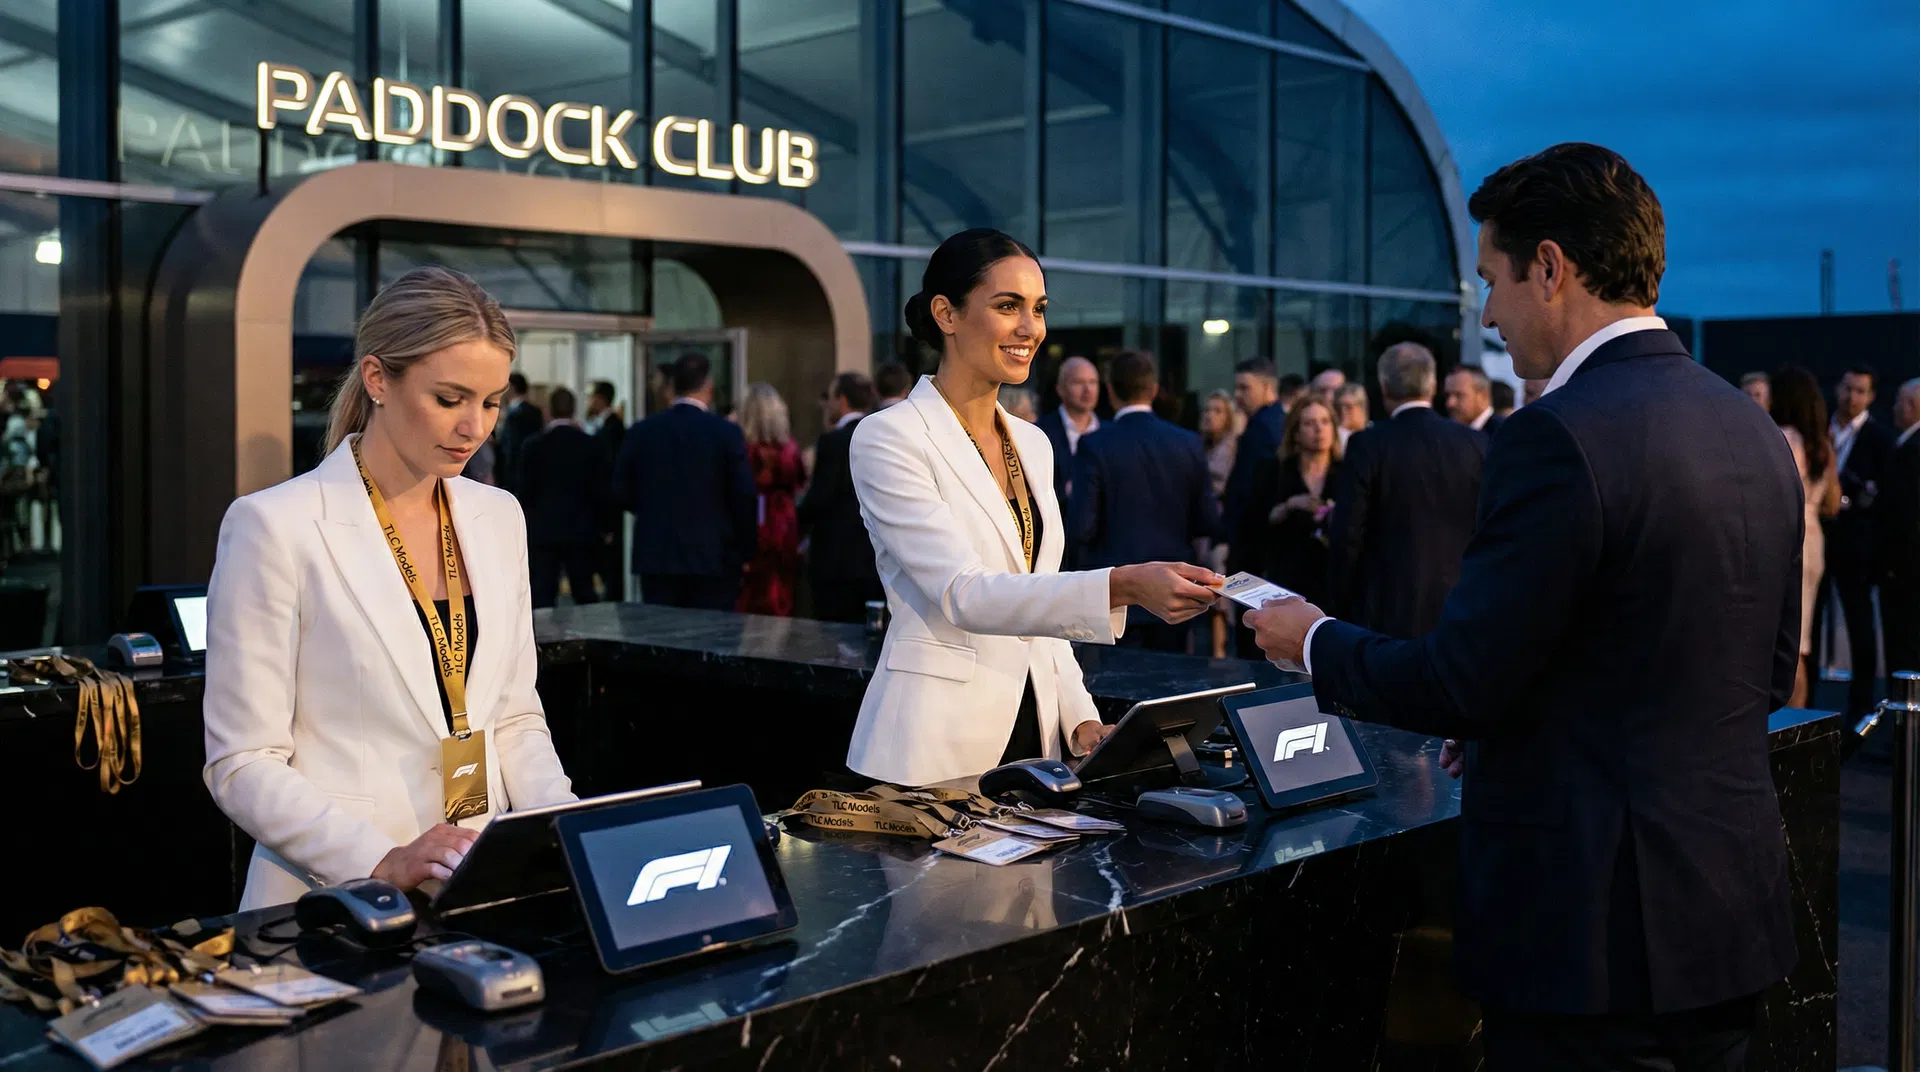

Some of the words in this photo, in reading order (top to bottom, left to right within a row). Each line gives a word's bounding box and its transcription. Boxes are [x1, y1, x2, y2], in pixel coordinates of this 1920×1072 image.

[257, 61, 638, 169] PADDOCK
[653, 115, 818, 188] CLUB
[383, 523, 401, 546] TLC
[393, 545, 418, 584] Models
[446, 558, 458, 580] TLC
[430, 614, 443, 637] TLC
[437, 636, 454, 678] Models
[453, 613, 464, 652] Models
[454, 653, 464, 674] TLC
[1273, 722, 1328, 763] F1
[451, 762, 479, 779] F1
[831, 800, 848, 811] TLC
[847, 802, 880, 814] Models
[874, 820, 889, 831] TLC
[626, 844, 732, 906] F1
